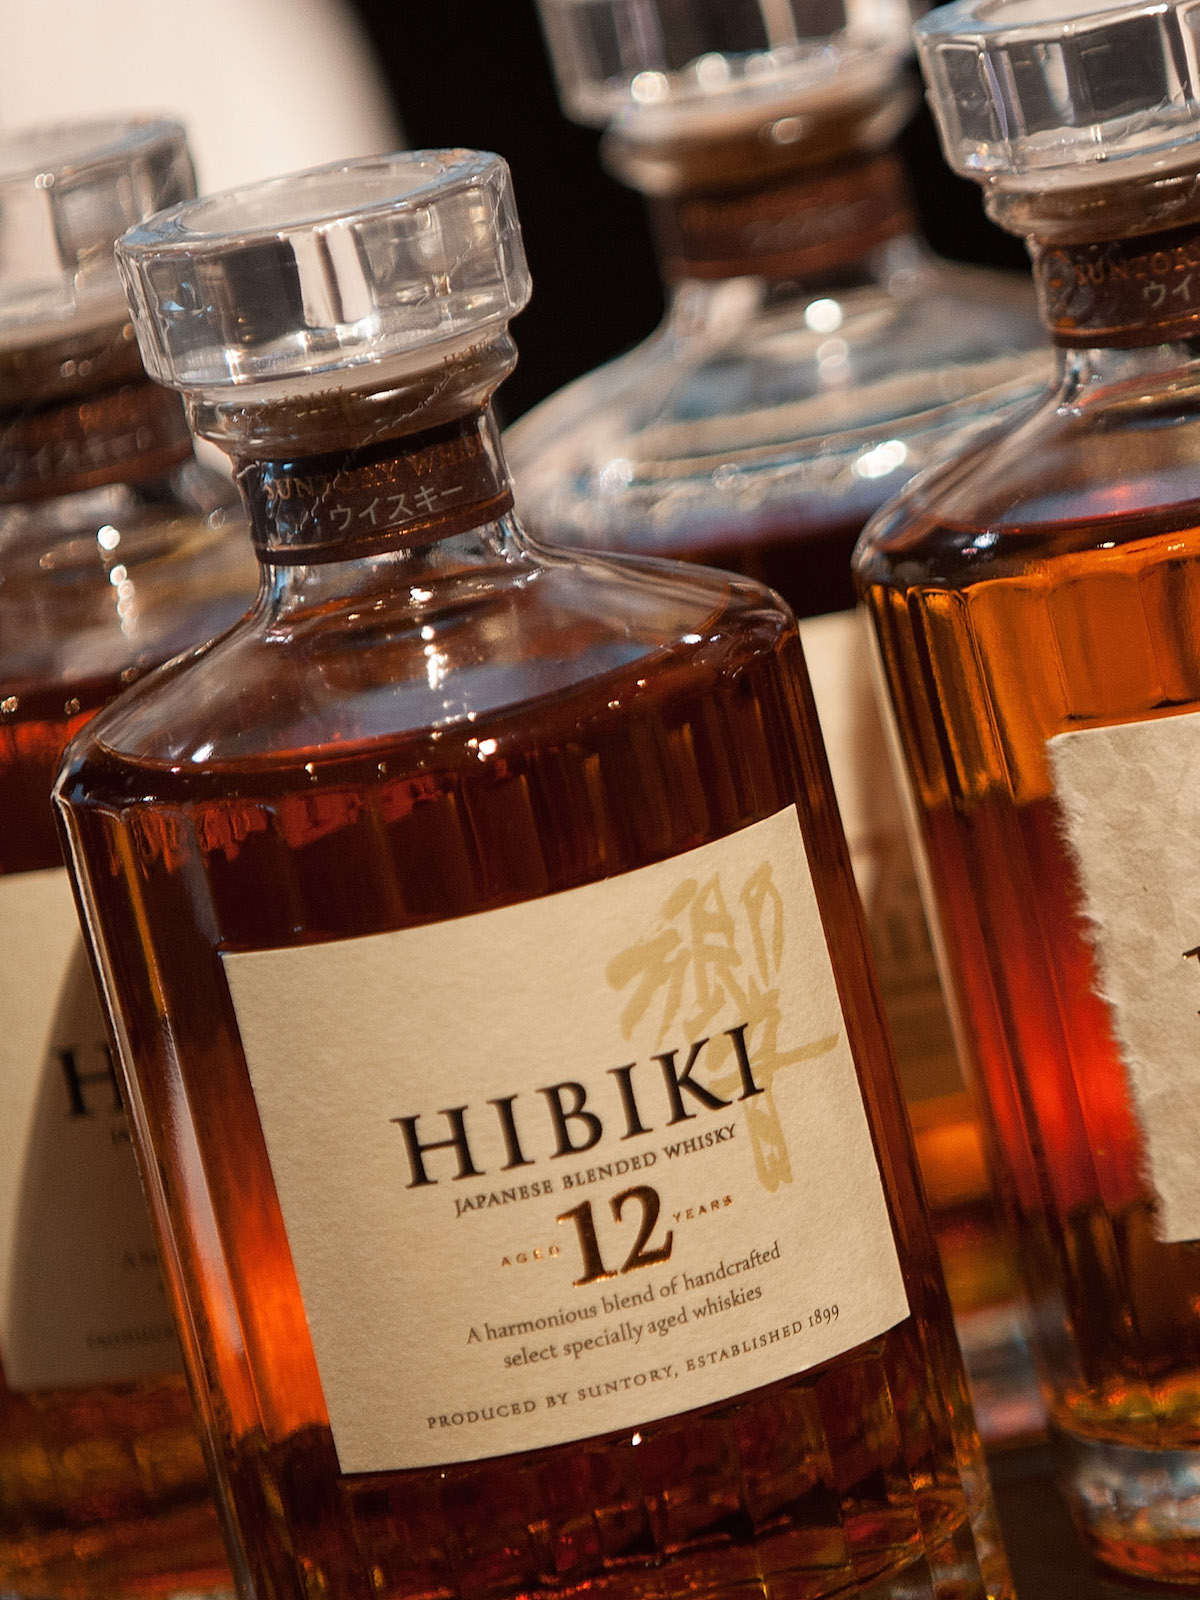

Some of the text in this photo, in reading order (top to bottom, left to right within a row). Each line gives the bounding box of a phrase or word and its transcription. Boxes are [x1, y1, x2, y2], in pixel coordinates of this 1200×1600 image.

[330, 485, 463, 530] ウイスキー
[605, 860, 839, 1193] 響
[389, 1022, 764, 1190] HIBIKI
[454, 1123, 737, 1218] JAPANESE BLENDED WHISKY
[501, 1184, 733, 1288] AGED 12 YEARS
[466, 1240, 782, 1345] A harmonious blend of handcrafted
[503, 1284, 763, 1369] select specially aged whiskies
[426, 1304, 840, 1429] PRODUCED BY SUNTORY, ESTABLISHED 1899
